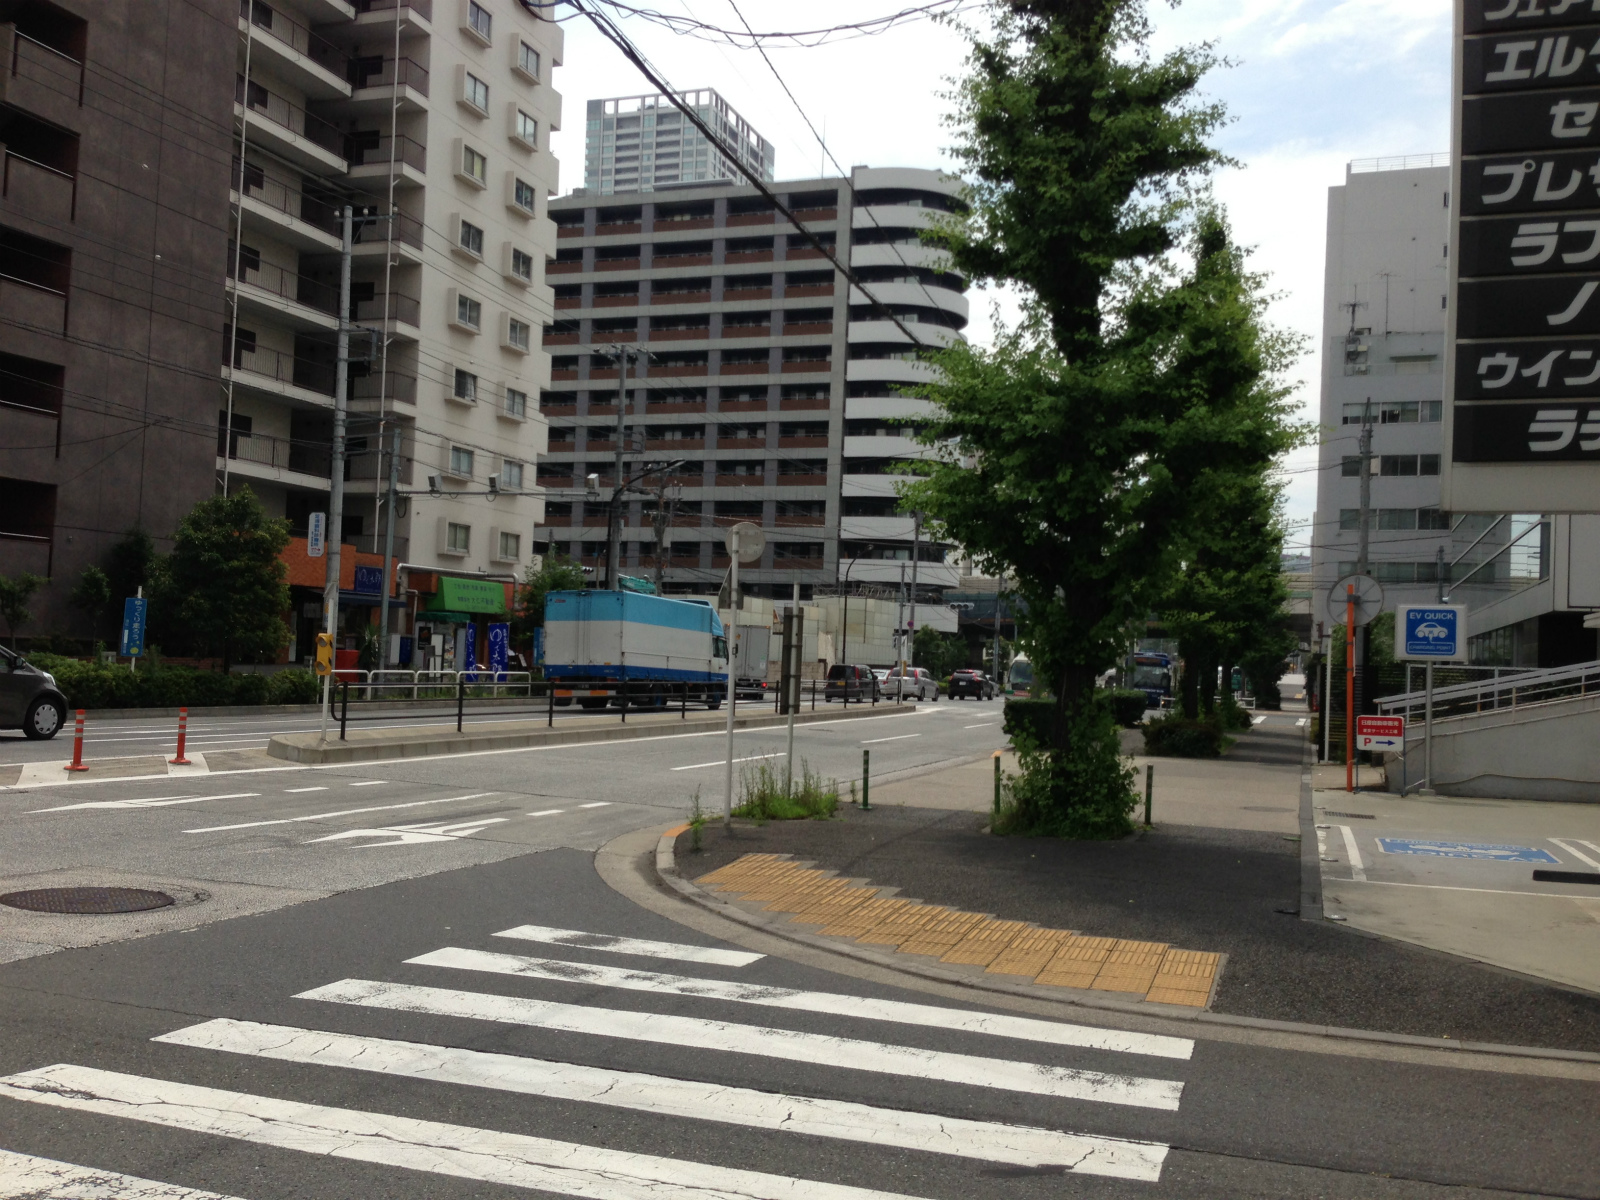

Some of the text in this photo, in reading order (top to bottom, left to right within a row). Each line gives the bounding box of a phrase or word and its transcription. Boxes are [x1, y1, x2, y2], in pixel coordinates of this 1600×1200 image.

[1485, 36, 1600, 82] エル
[1550, 100, 1599, 138] セ
[1482, 159, 1600, 204] プレ
[132, 600, 142, 640] ゆっくり走ろう
[1410, 612, 1454, 620] EV QUICK
[1363, 737, 1372, 747] P
